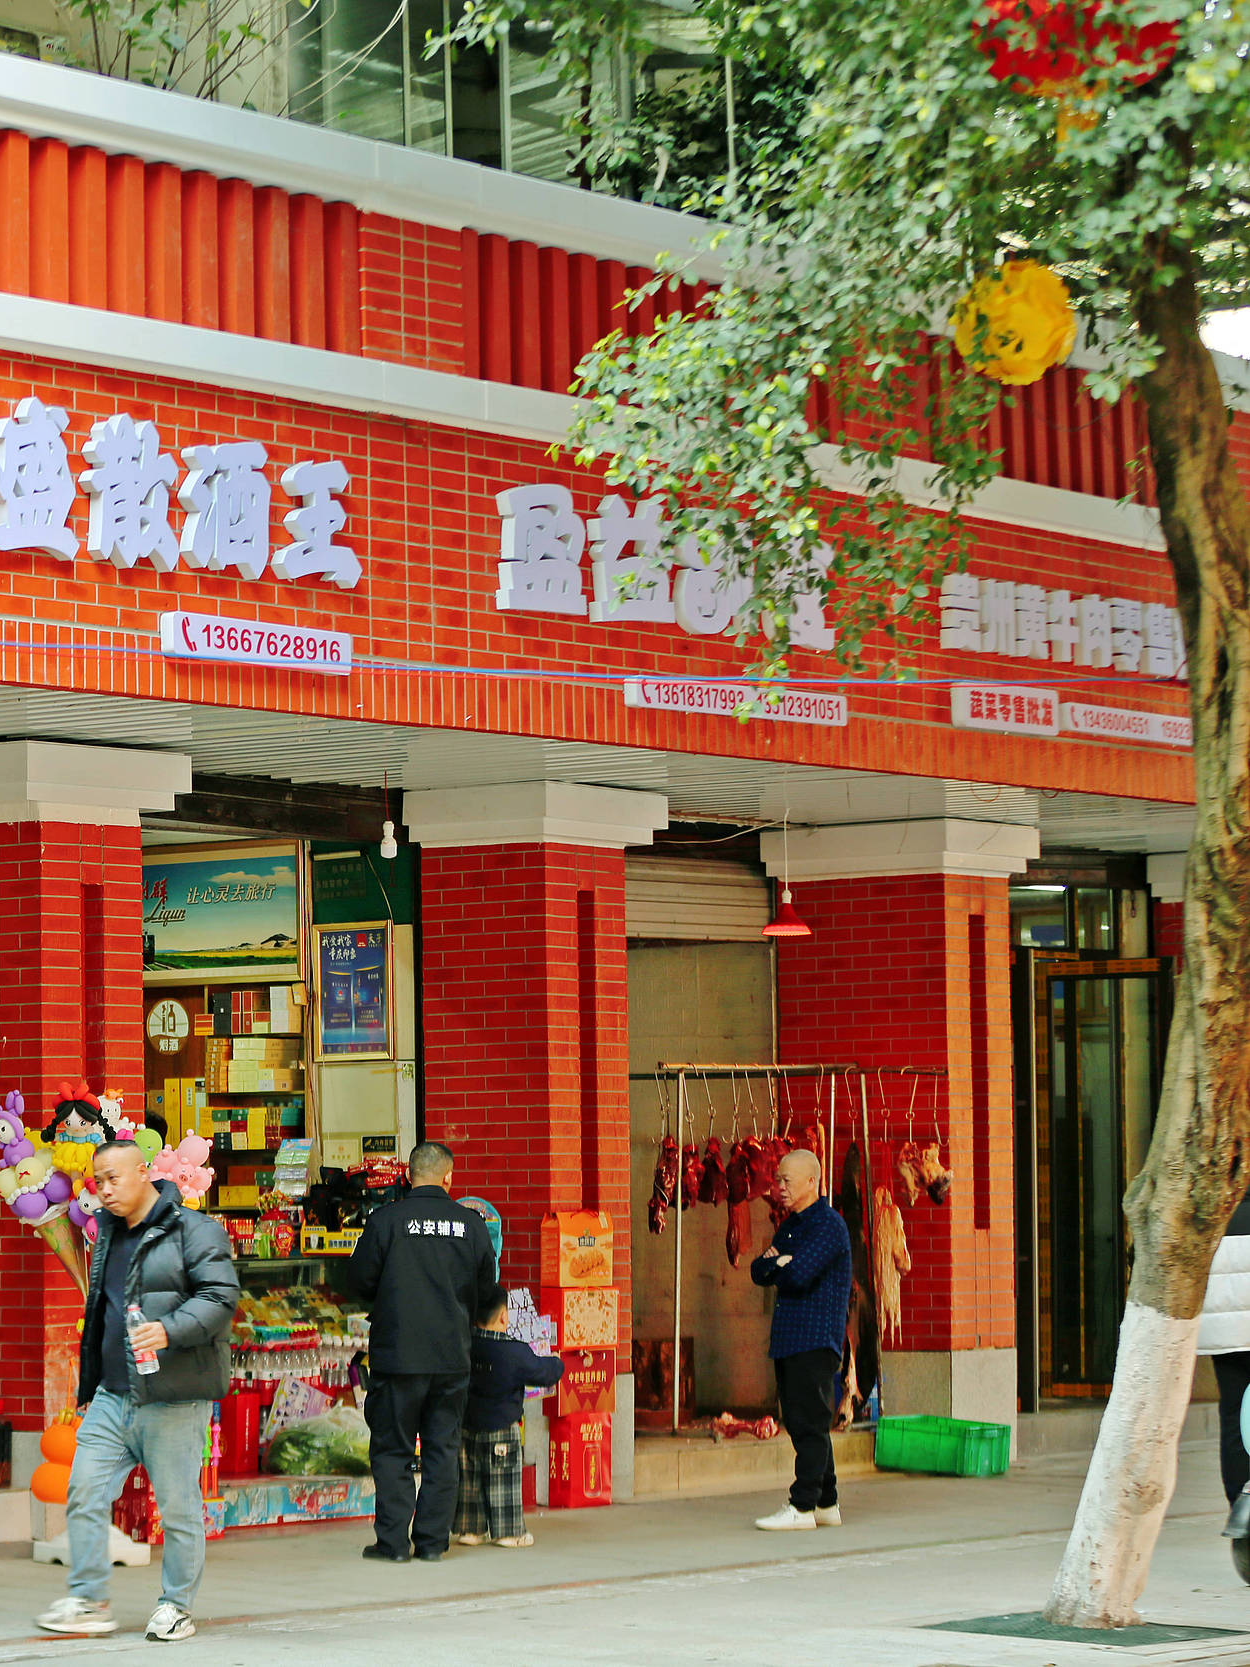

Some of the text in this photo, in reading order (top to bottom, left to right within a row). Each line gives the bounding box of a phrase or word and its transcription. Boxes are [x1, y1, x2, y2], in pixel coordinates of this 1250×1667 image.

[939, 573, 1188, 680] 贵州黄牛肉零售
[201, 623, 342, 662] 13667628916
[970, 690, 1054, 727] 蔬菜零售批发
[186, 882, 277, 905] 让心灵去旅行
[144, 898, 187, 927] Liqun
[159, 1038, 179, 1052] 烟酒
[407, 1219, 466, 1238] 公安辅警
